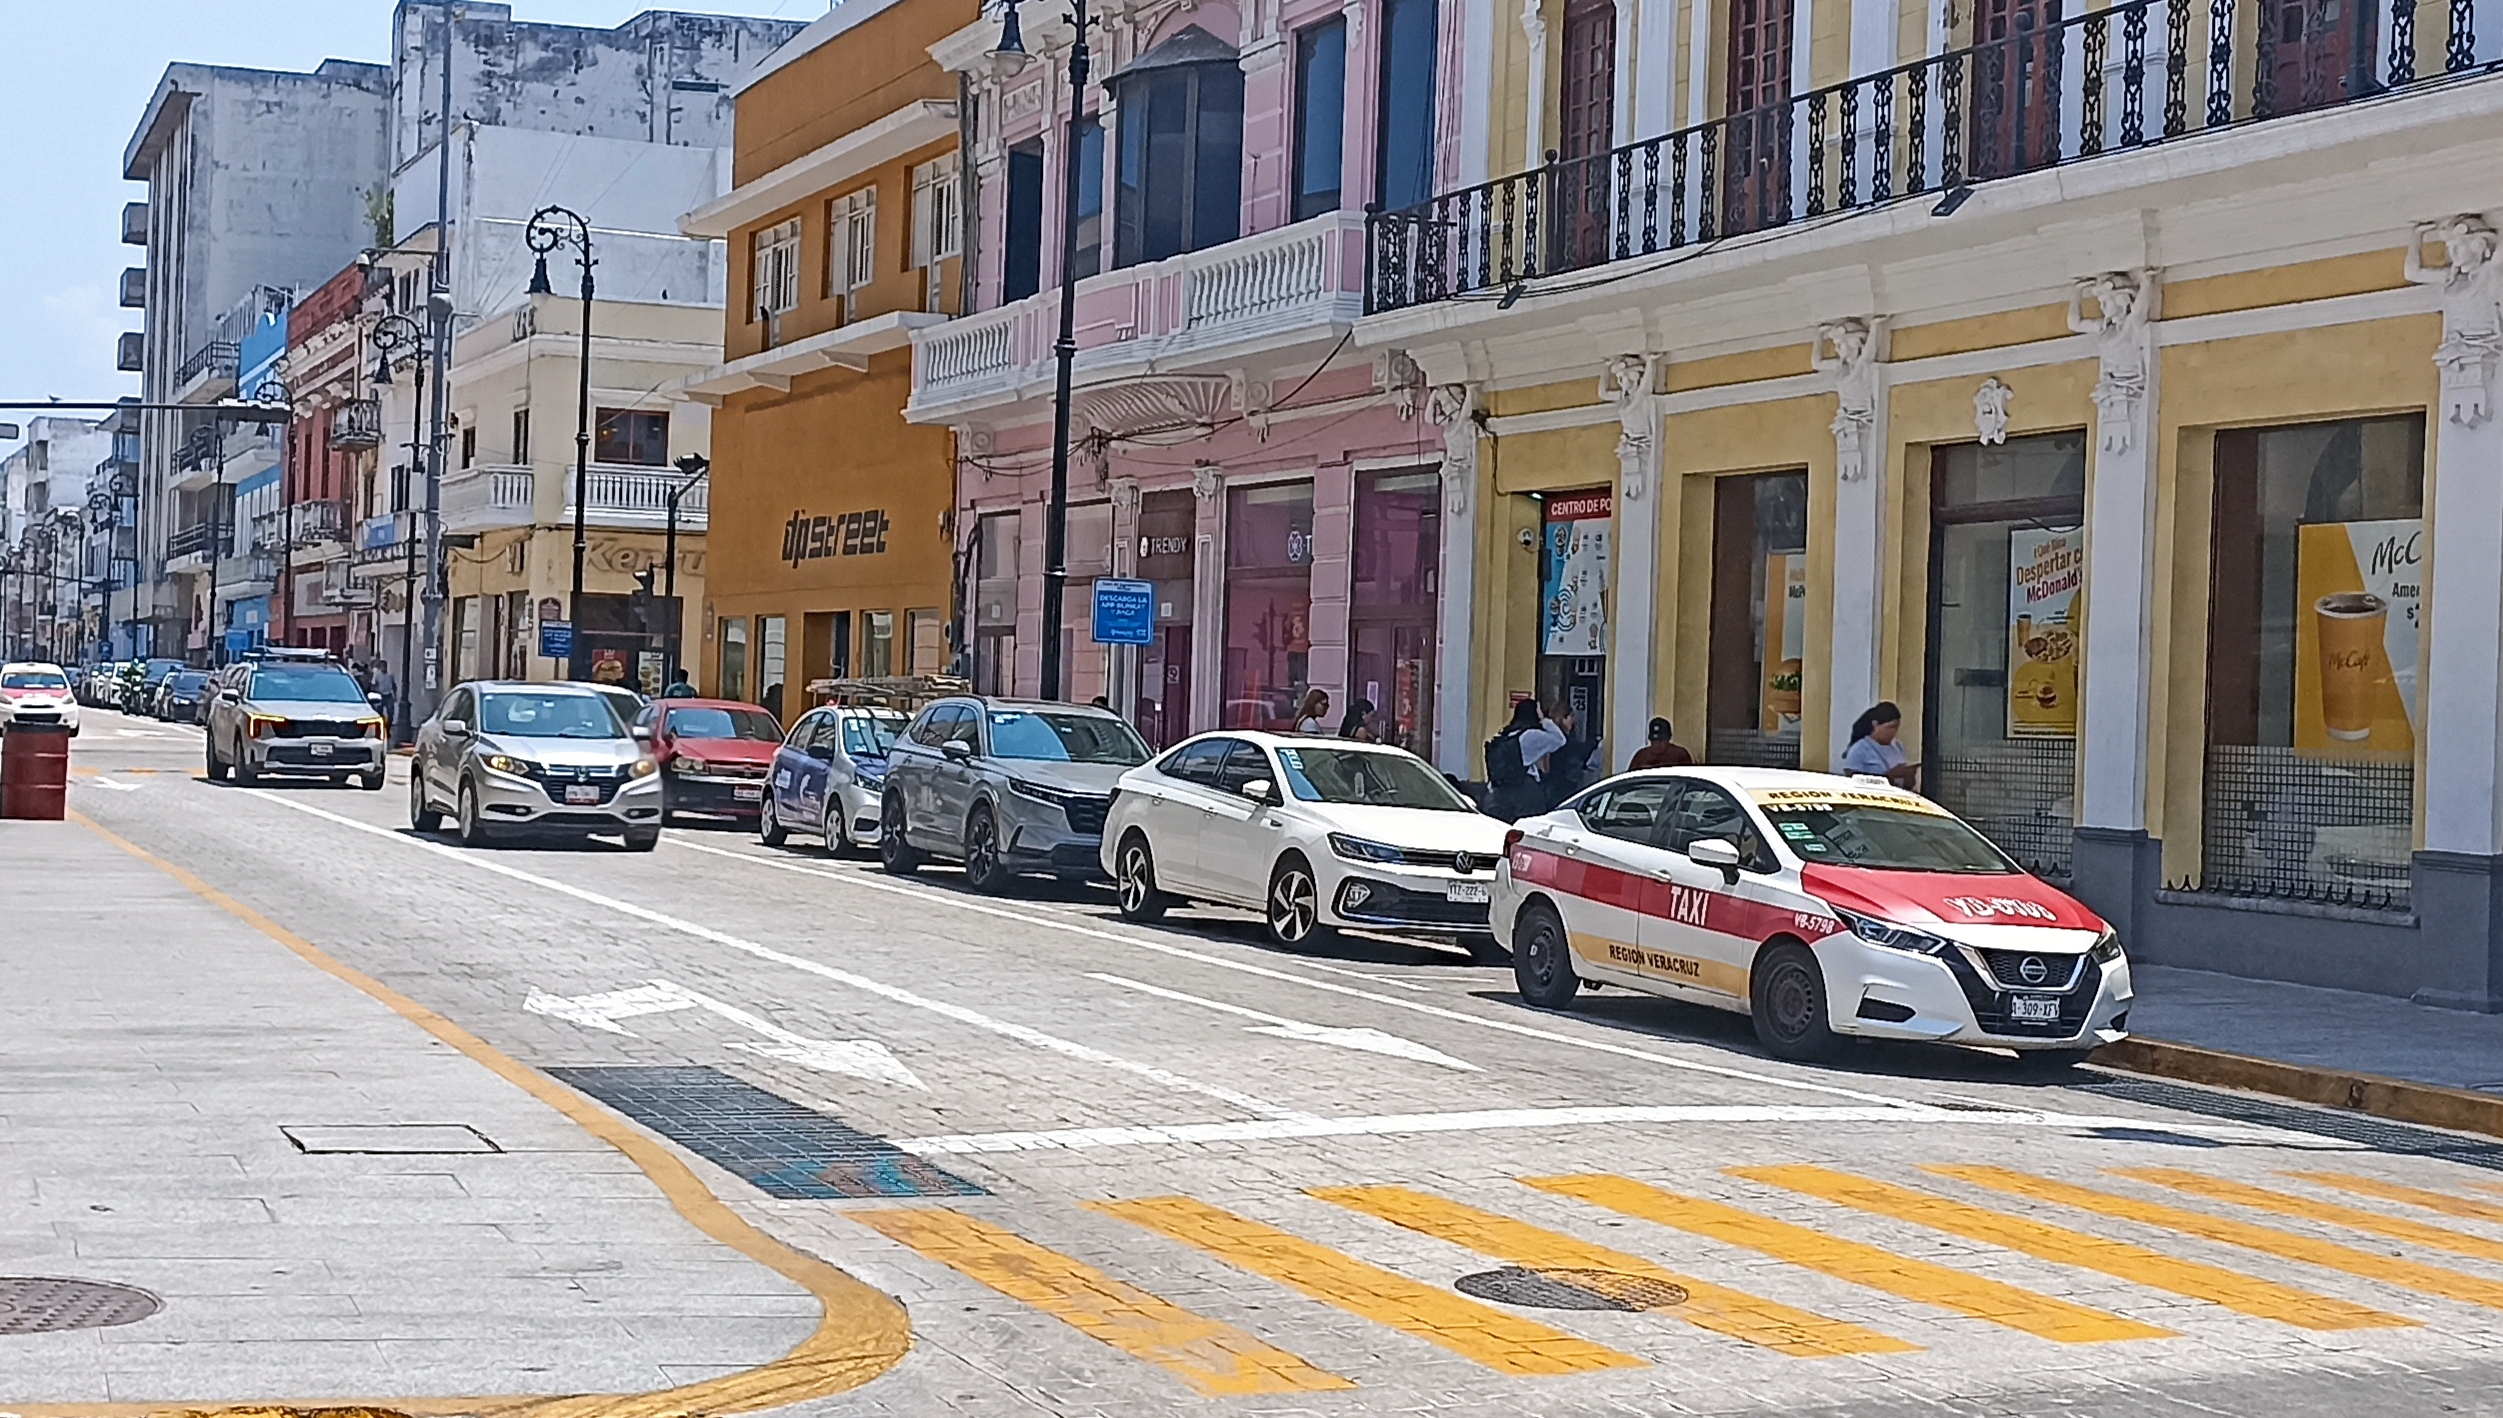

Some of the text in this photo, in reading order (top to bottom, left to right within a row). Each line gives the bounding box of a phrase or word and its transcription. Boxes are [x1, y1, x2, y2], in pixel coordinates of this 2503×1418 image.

[1551, 500, 1585, 515] CENTRO
[1587, 499, 1598, 512] DE
[584, 537, 707, 576] Kenu
[1150, 537, 1187, 554] TRENDY
[2016, 551, 2071, 586] Despertar
[1768, 791, 1832, 799] REGION
[1670, 885, 1710, 926] TAXI
[1794, 913, 1835, 934] VB-5798
[1609, 944, 1700, 977] REGION VERACRUZ
